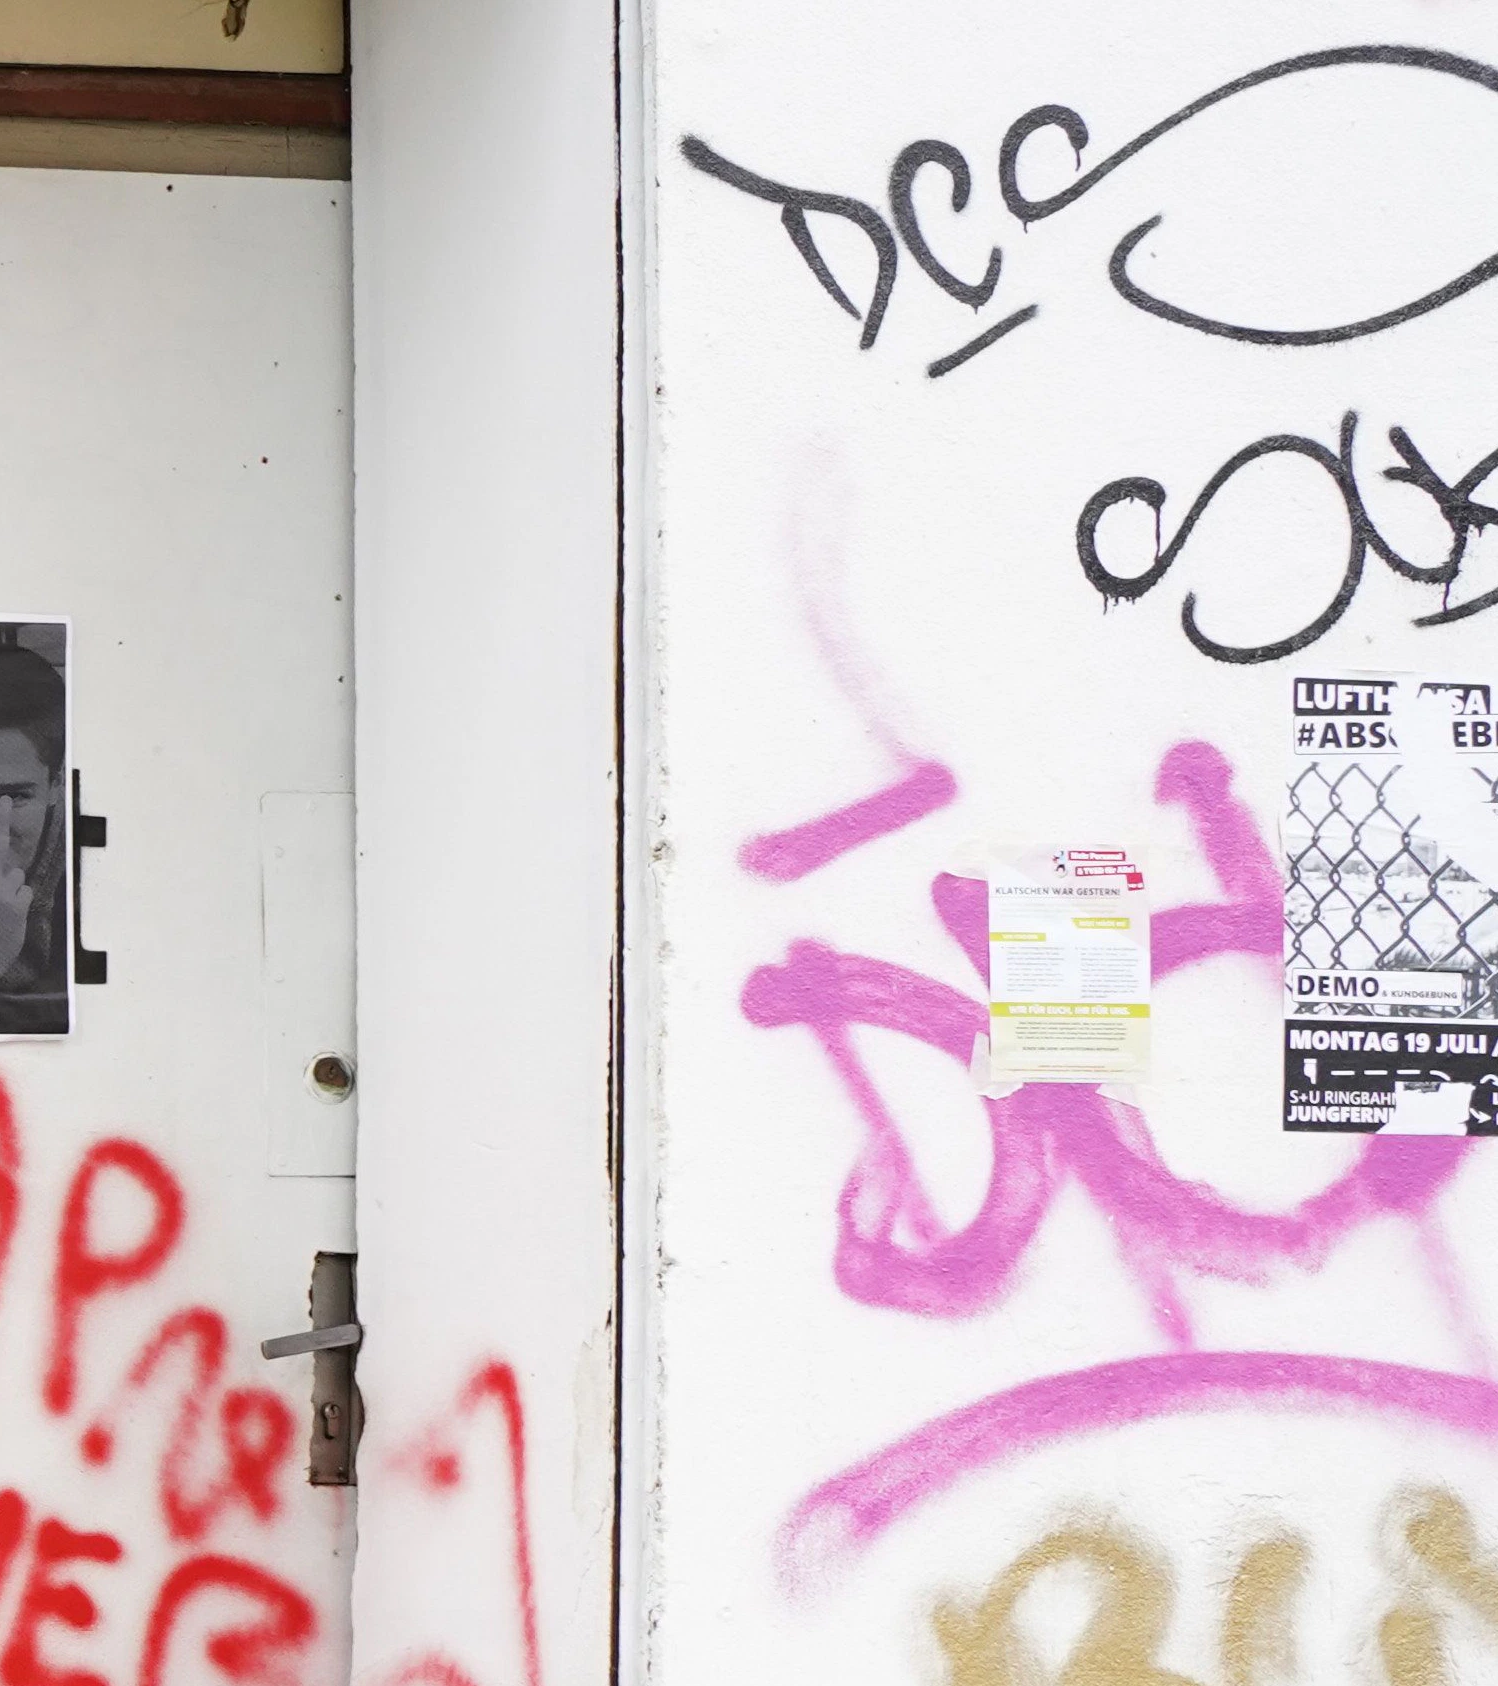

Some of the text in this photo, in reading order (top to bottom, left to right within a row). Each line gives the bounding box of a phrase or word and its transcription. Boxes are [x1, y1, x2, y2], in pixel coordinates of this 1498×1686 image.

[995, 887, 1121, 897] KLATSCHEN WAR GESTERN!
[1297, 974, 1380, 998] DEMO
[1390, 990, 1458, 1000] KUNDGEBUNG
[1289, 1029, 1488, 1056] MONTAG 19 JULI
[1289, 1089, 1320, 1105] S+U
